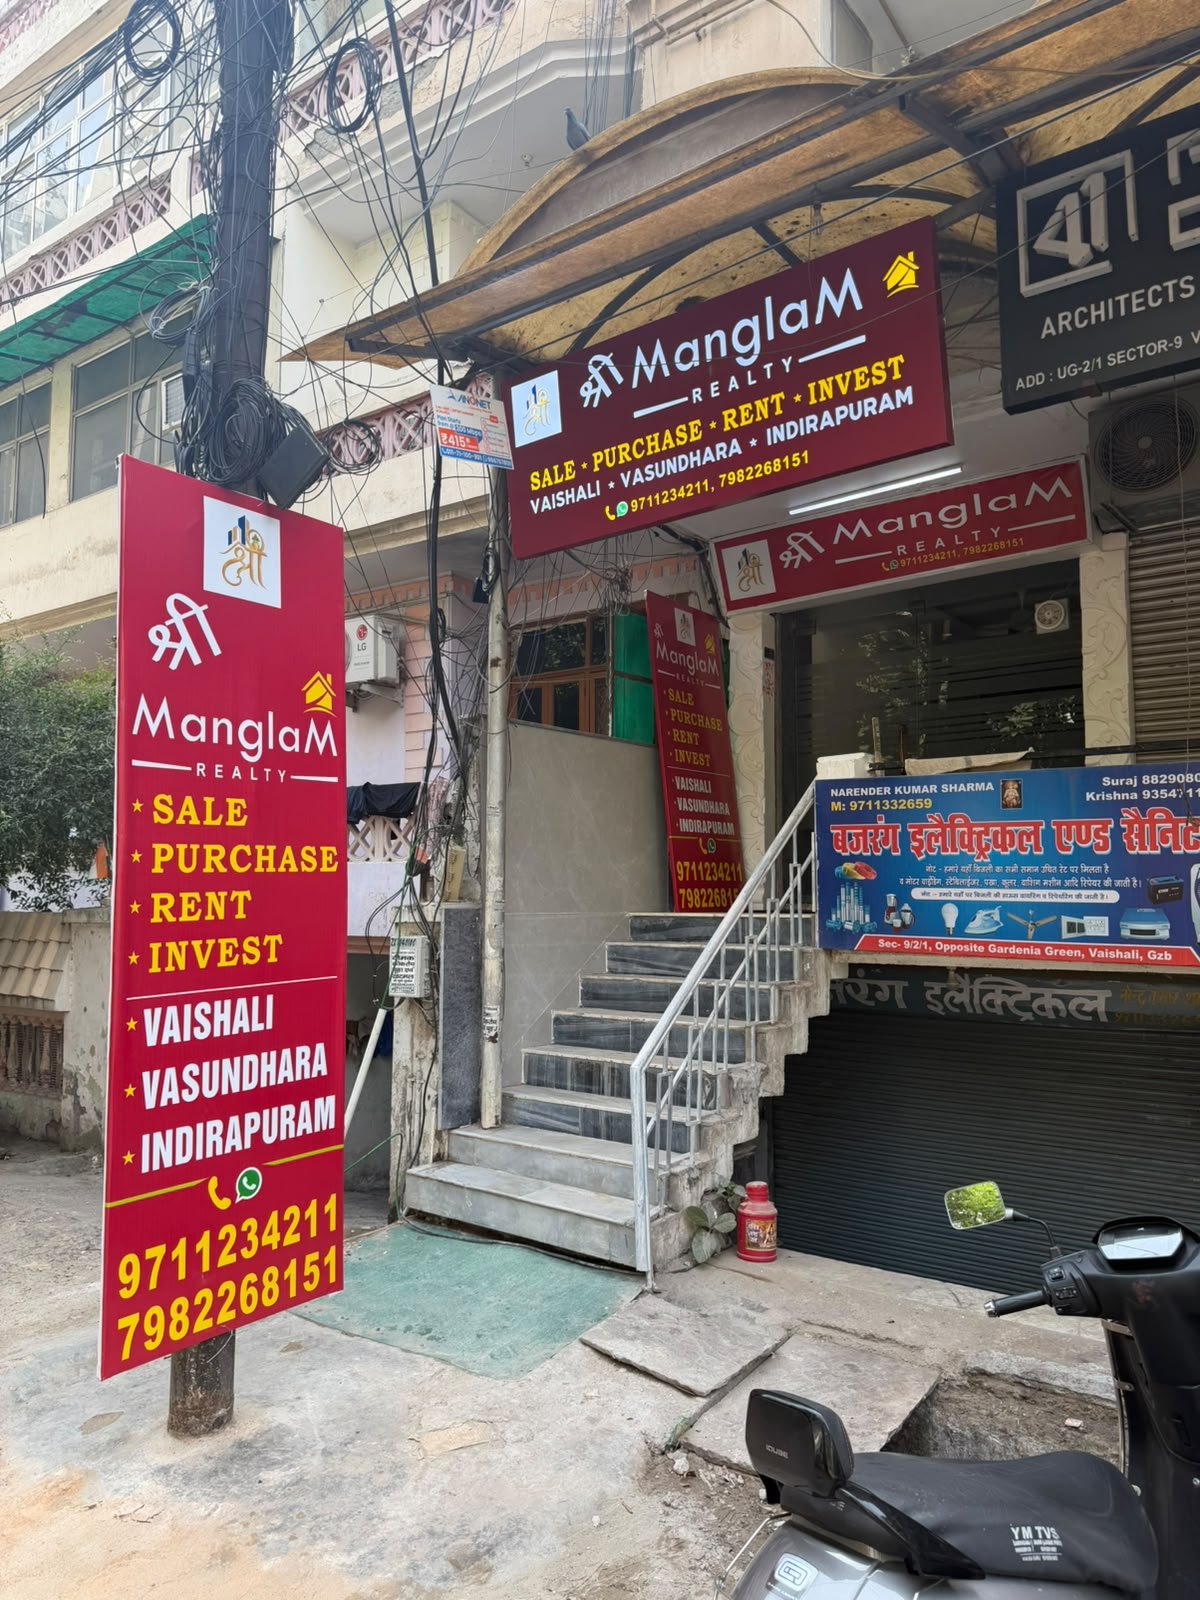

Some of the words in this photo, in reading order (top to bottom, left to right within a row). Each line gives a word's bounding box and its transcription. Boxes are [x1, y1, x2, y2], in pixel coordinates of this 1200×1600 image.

[1040, 274, 1196, 339] ARCHITECTS
[580, 352, 624, 408] श्री
[631, 267, 864, 390] ManglaM
[1016, 373, 1045, 391] ADD
[1057, 356, 1102, 380] UG-2/1
[1107, 336, 1183, 367] SECTOR-9
[692, 356, 793, 404] REALTY
[530, 460, 576, 491] SALE
[592, 419, 703, 472] PURCHASE
[722, 391, 785, 432] RENT
[808, 354, 905, 406] INVEST
[530, 480, 601, 515] VAISHALI
[620, 438, 742, 488] VASUNDHARA
[767, 385, 914, 446] INDIRAPURAM
[630, 478, 714, 513] 9711234211,
[719, 449, 809, 489] 7982268151
[778, 530, 825, 569] श्री
[833, 475, 1073, 545] ManglaM
[897, 527, 1000, 556] REALTY
[900, 549, 961, 568] 9711234211,
[964, 537, 1025, 556] 7982268151
[148, 592, 222, 671] श्री
[357, 643, 367, 651] LG
[656, 641, 720, 676] ManglaM
[668, 688, 695, 706] SALE
[131, 693, 338, 763] ManglaM
[670, 712, 723, 731] PURCHASE
[672, 729, 700, 746] RENT
[196, 762, 287, 783] REALTY
[674, 752, 711, 768] INVEST
[675, 775, 712, 794] VAISHALI
[830, 787, 891, 797] NARENDER
[894, 784, 938, 795] KUMAR
[941, 782, 994, 793] SHARMA
[1086, 789, 1138, 801] Krishna
[1102, 776, 1138, 787] Suraj
[152, 794, 248, 826] SALE
[677, 800, 731, 816] VASUNDHARA
[831, 801, 846, 812] M:
[850, 798, 933, 811] 9711332659
[679, 821, 735, 837] INDIRAPURAM
[830, 814, 901, 856] बजरंग
[1051, 818, 1113, 856] एण्ड
[151, 843, 339, 874] PURCHASE
[676, 861, 743, 882] 9711234211
[150, 890, 252, 923] RENT
[148, 934, 283, 974] INVEST
[878, 938, 901, 948] Sec-
[904, 940, 932, 951] 9/2/1,
[935, 941, 985, 953] Opposite
[988, 943, 1041, 955] Gardenia
[1044, 946, 1085, 959] Green,
[1088, 948, 1143, 961] Vaishali,
[1147, 950, 1172, 961] Gzb
[143, 994, 274, 1047] VAISHALI
[141, 1043, 328, 1110] VASUNDHARA
[141, 1094, 336, 1174] INDIRAPURAM
[118, 1193, 337, 1299] 9711234211
[117, 1245, 337, 1361] 7982268151
[1034, 1525, 1060, 1539] TVS
